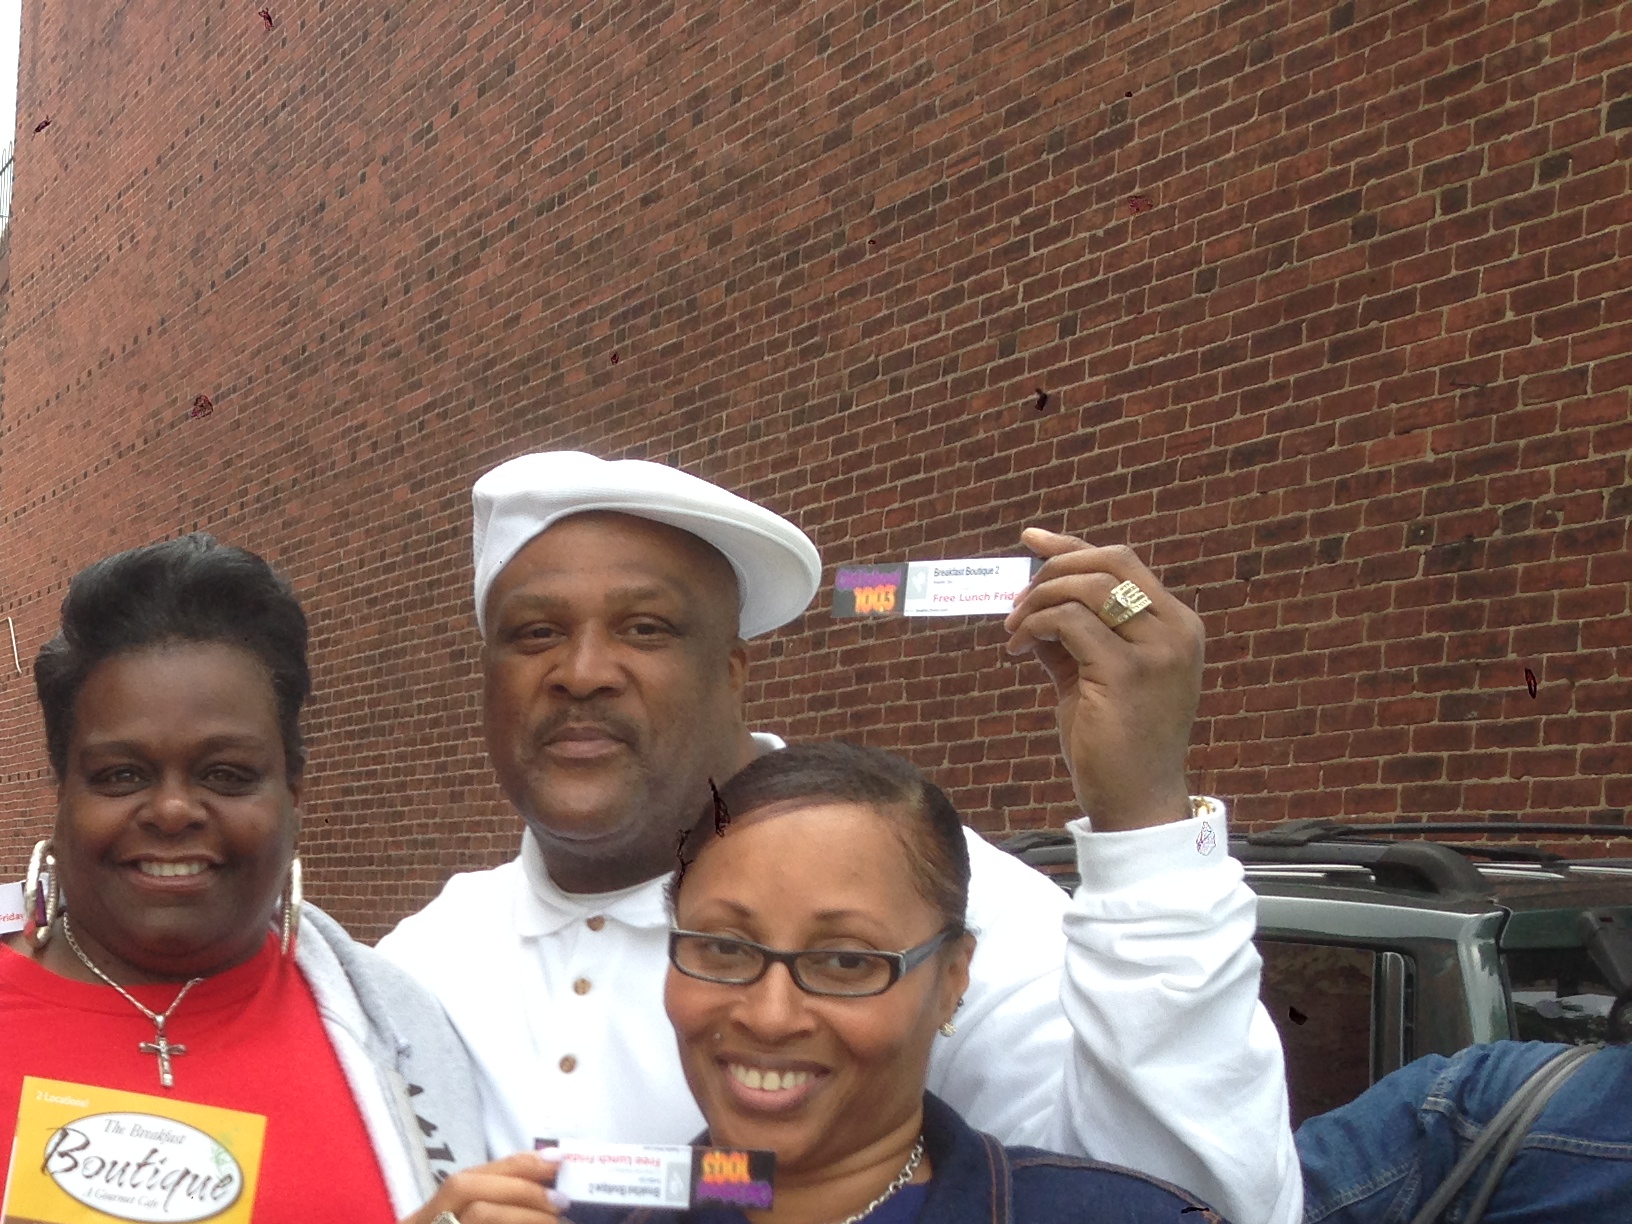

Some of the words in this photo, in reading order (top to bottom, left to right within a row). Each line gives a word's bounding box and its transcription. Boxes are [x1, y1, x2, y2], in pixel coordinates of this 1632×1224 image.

[966, 566, 994, 577] Boutique
[933, 594, 956, 603] Free
[959, 592, 991, 602] Lunch
[104, 1118, 126, 1134] The
[130, 1124, 186, 1145] Breakfast
[41, 1127, 234, 1213] Boutique
